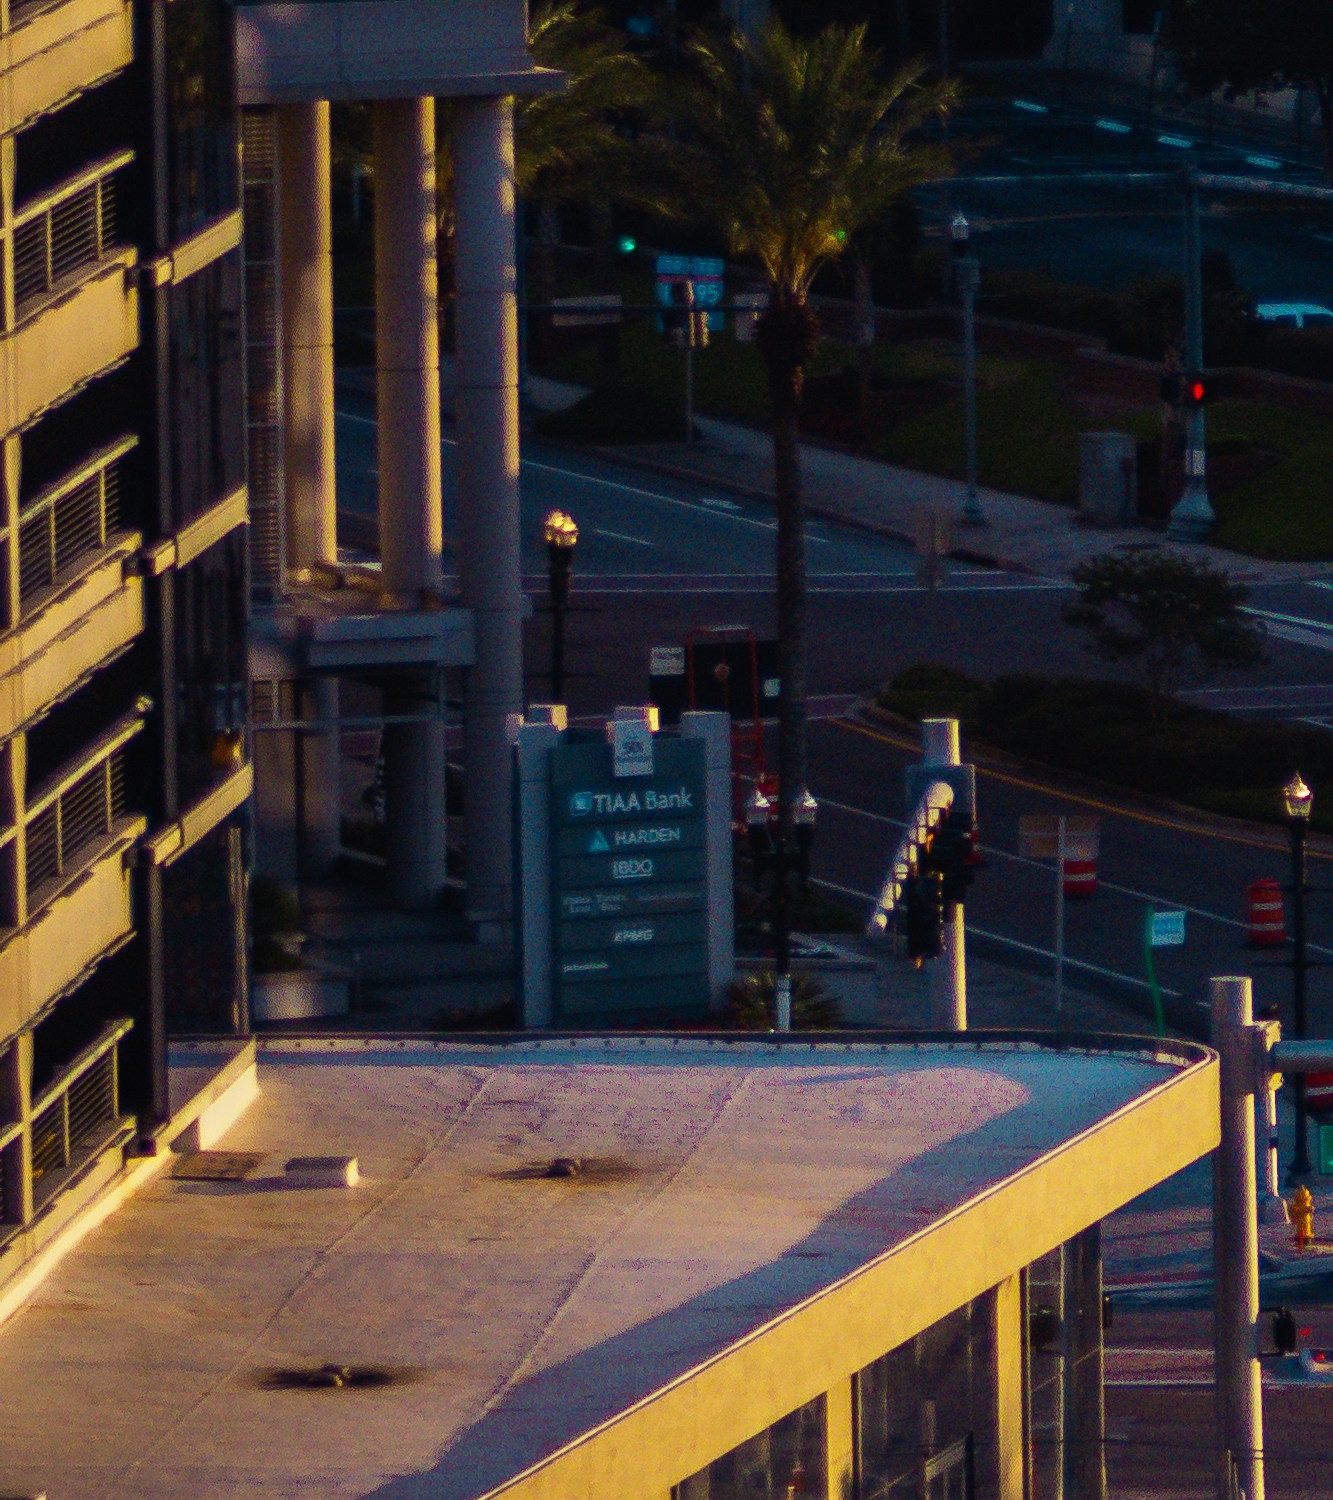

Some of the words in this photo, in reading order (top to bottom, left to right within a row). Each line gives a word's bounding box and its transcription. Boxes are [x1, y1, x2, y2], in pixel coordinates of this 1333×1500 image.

[592, 792, 642, 814] TIAA
[645, 786, 693, 810] Bank
[614, 827, 680, 846] HARDEN
